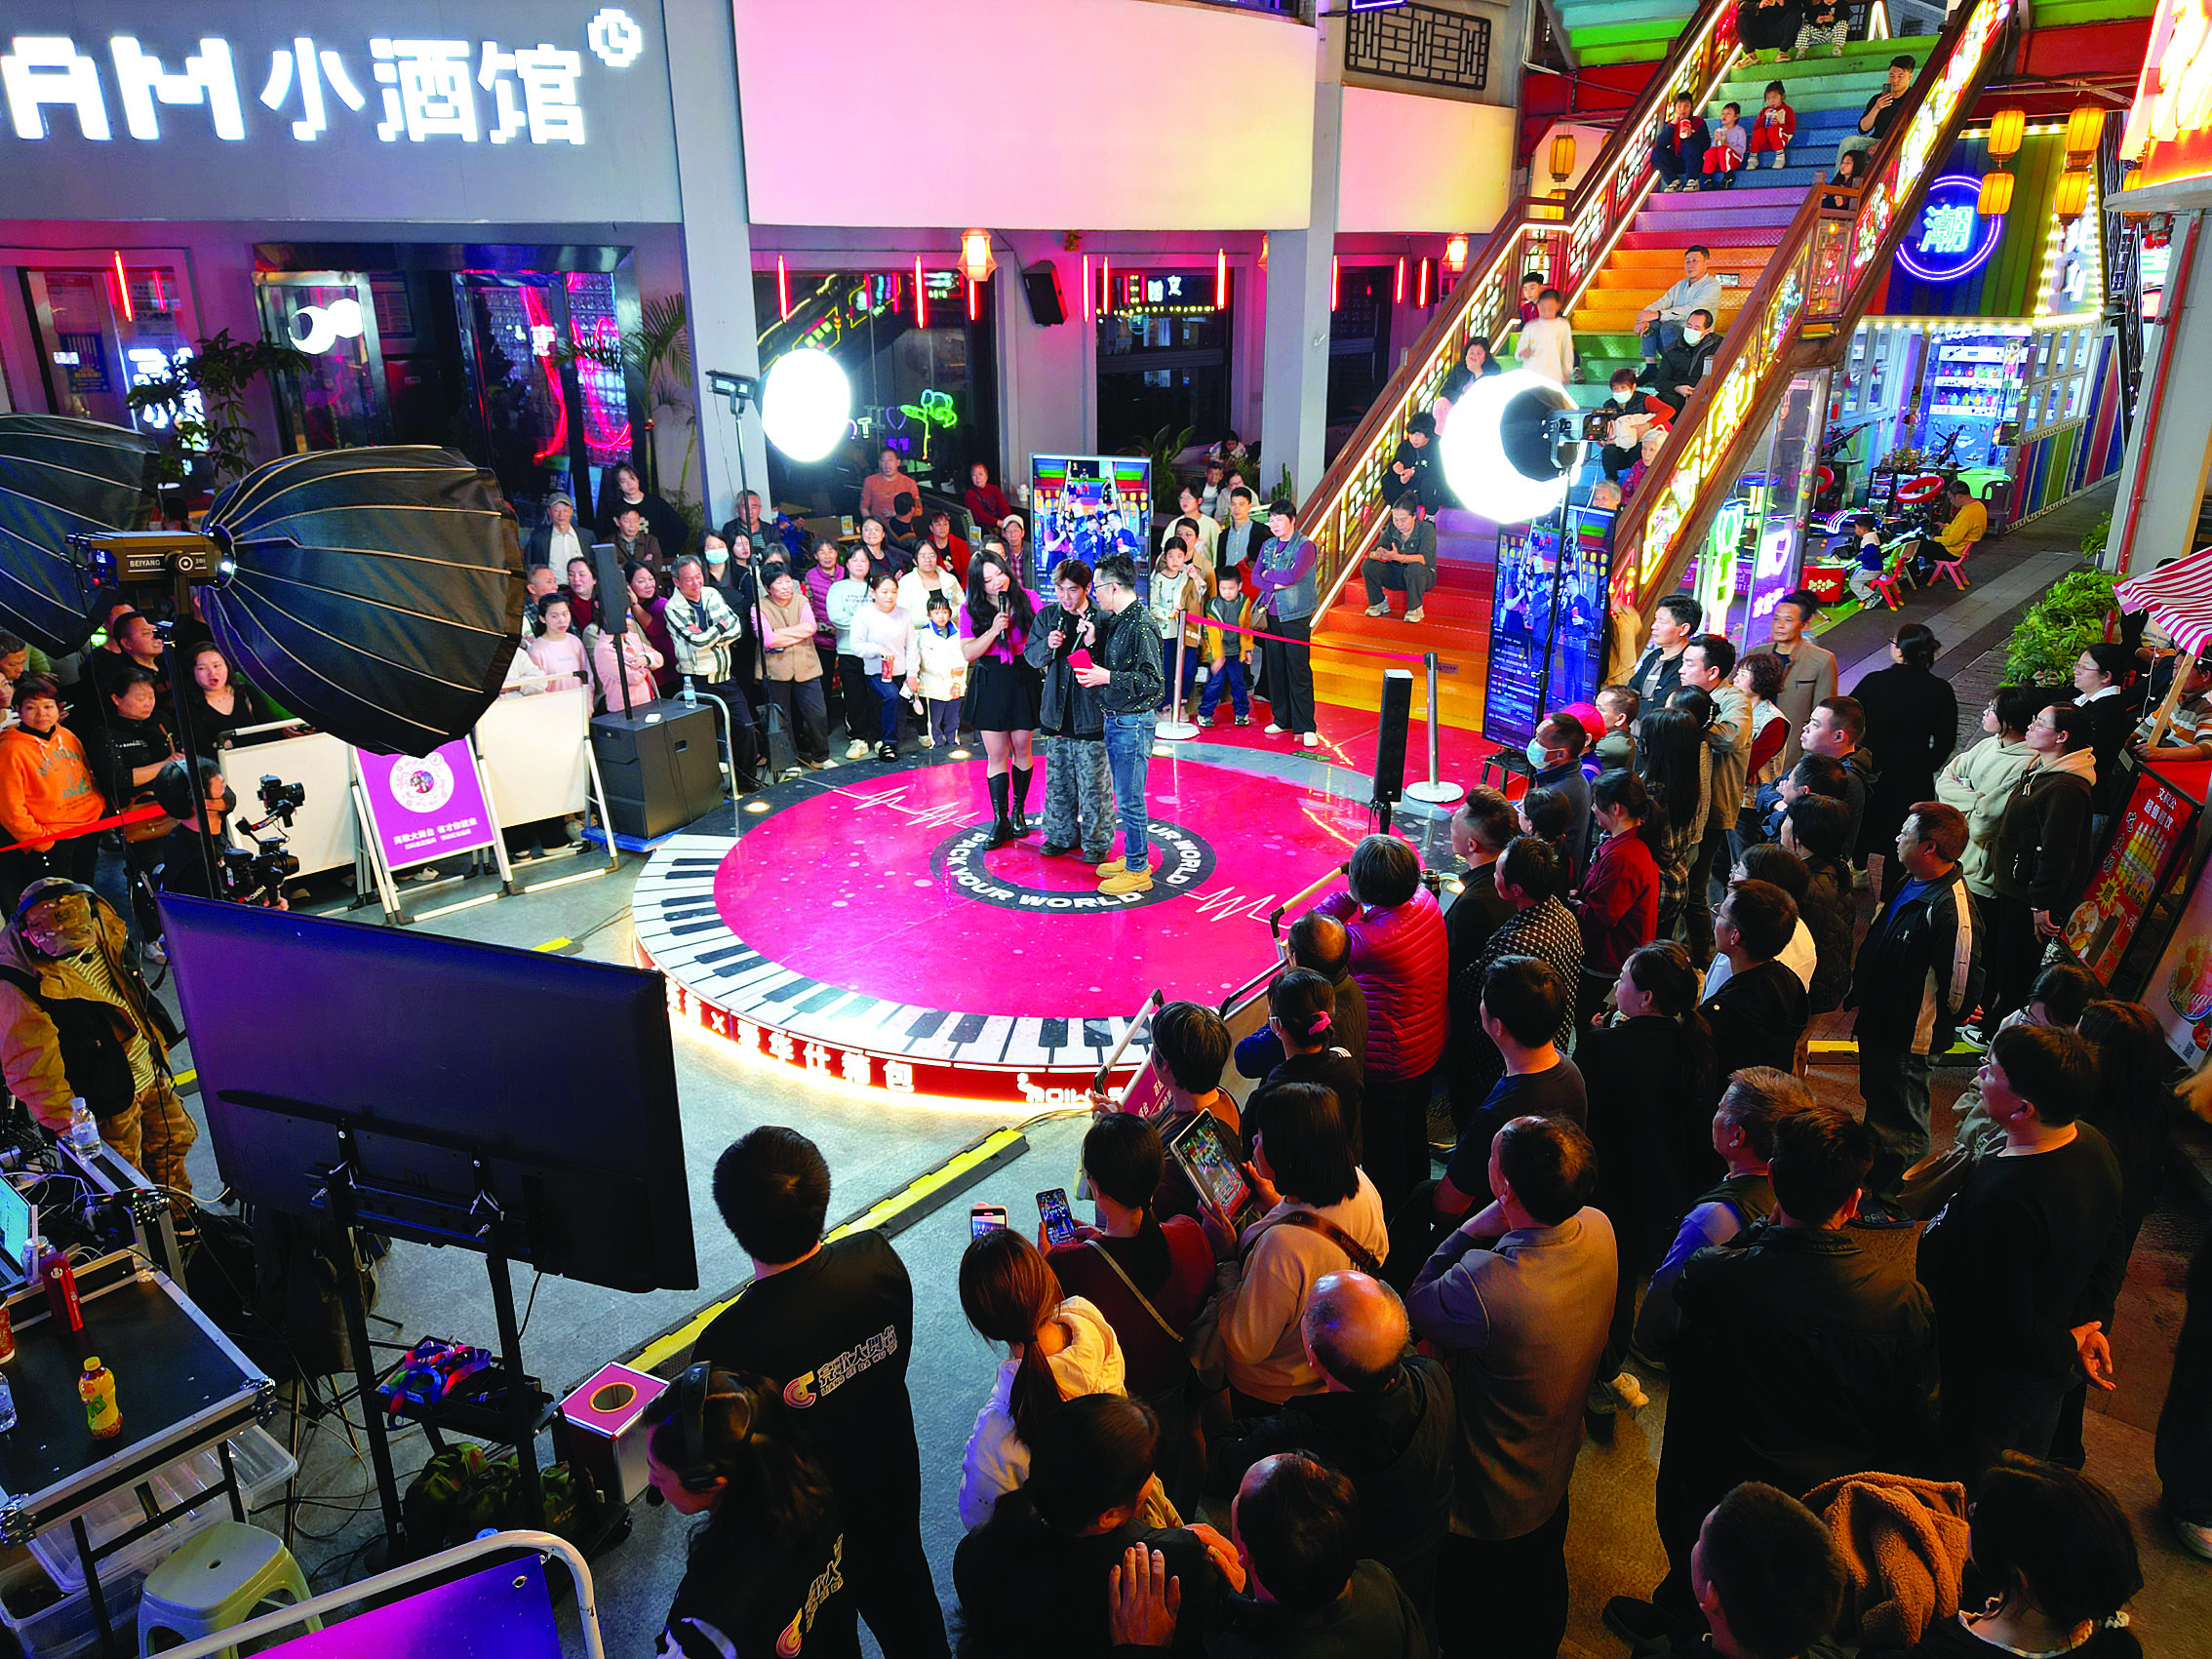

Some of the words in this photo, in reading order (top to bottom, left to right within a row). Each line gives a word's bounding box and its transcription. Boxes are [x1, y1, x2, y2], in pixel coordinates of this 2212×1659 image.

[259, 36, 586, 145] 小酒馆
[1919, 204, 1975, 253] 潮
[129, 558, 162, 569] BEIYANG
[946, 832, 989, 869] PACK
[950, 866, 1015, 901] YOUR
[1018, 891, 1145, 908] WORLD
[817, 1324, 897, 1388] 亮歌大舞台
[820, 1374, 845, 1397] LIANG
